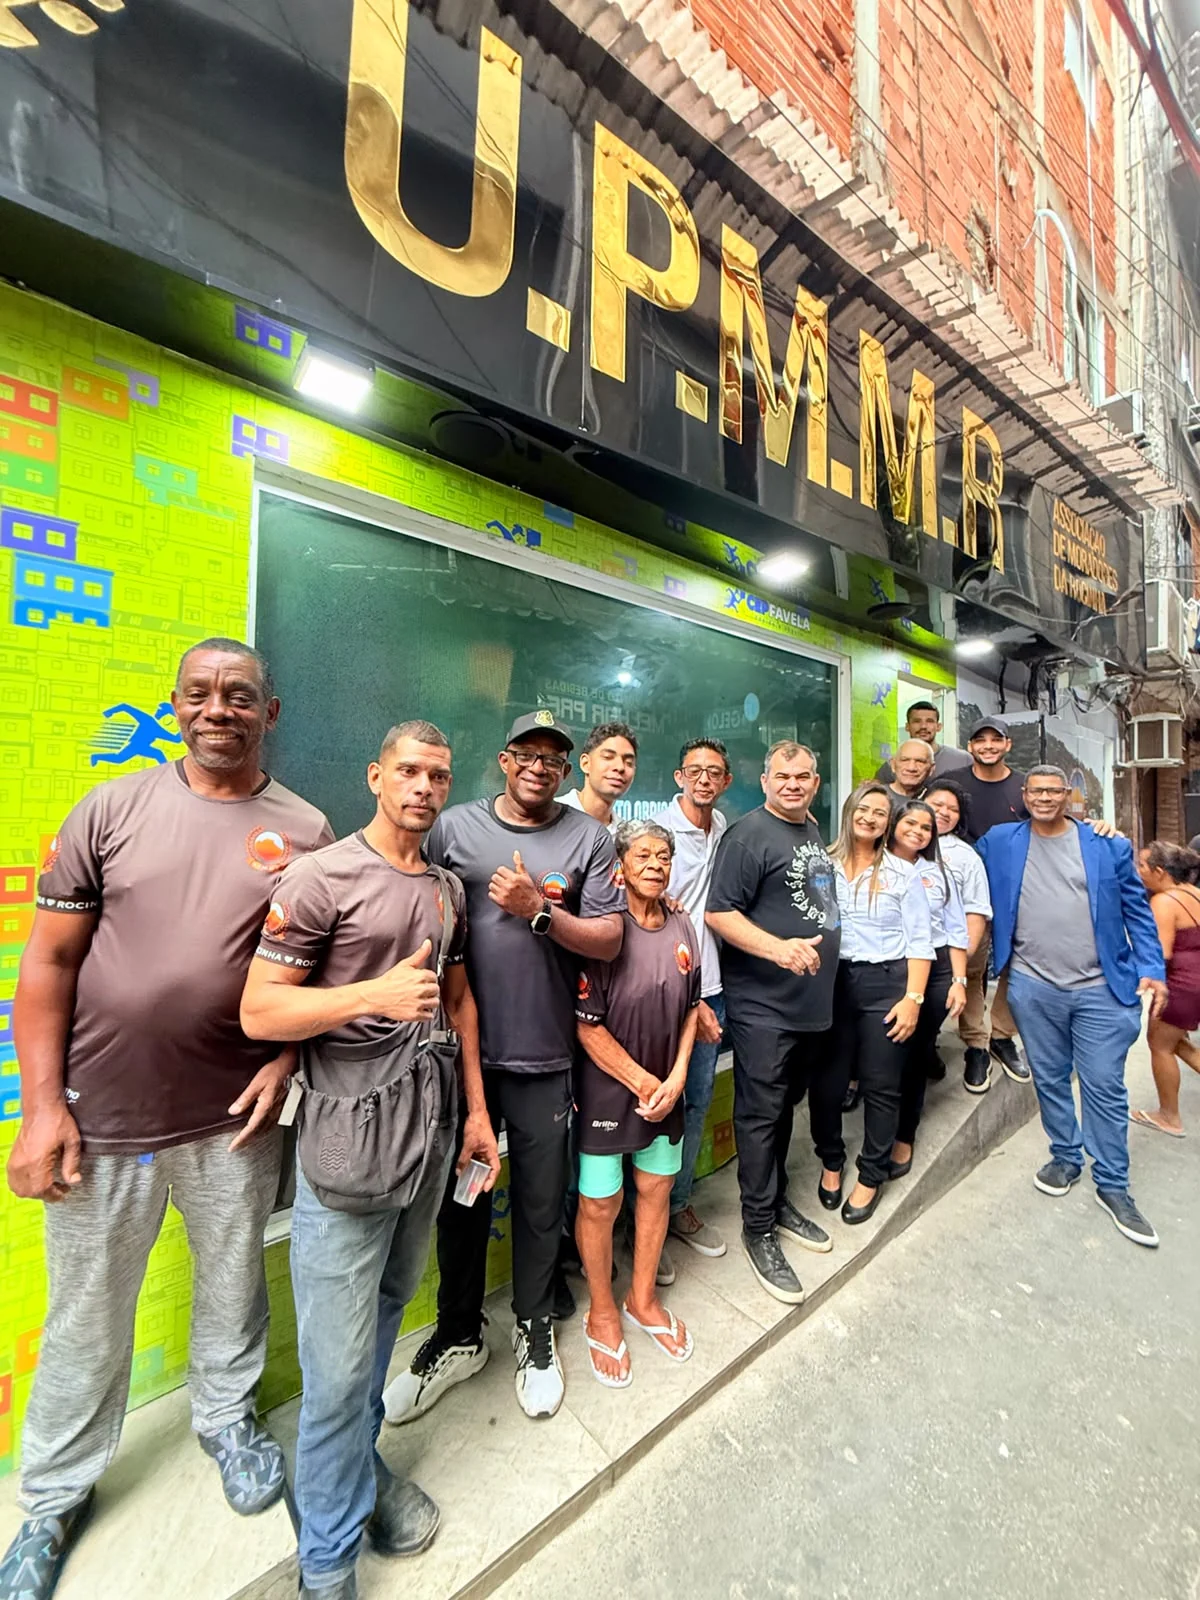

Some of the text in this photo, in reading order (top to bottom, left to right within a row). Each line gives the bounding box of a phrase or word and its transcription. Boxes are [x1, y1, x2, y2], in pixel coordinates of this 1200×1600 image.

[1053, 529, 1118, 593] DE MORADORES
[1053, 563, 1069, 596] DA
[591, 1119, 619, 1128] Brilho
